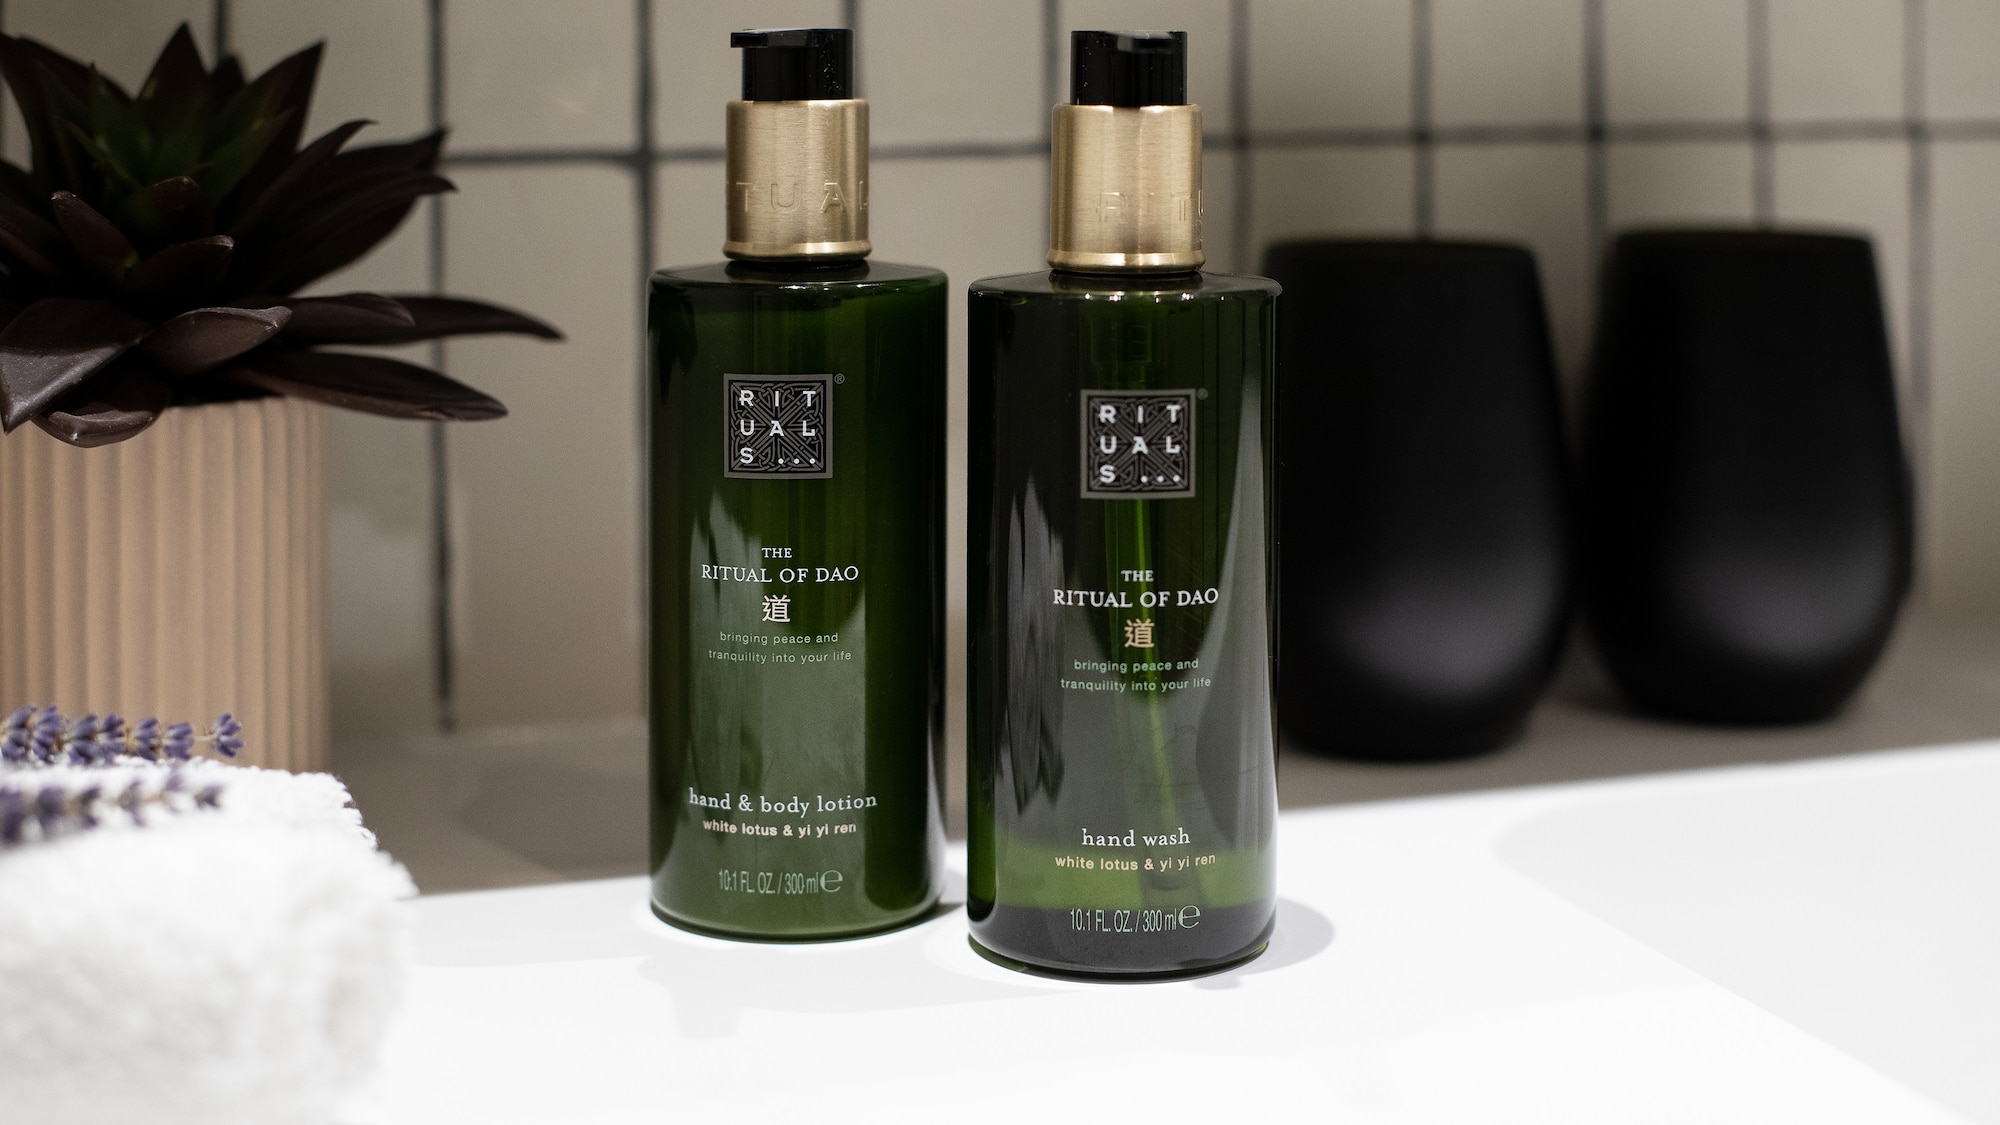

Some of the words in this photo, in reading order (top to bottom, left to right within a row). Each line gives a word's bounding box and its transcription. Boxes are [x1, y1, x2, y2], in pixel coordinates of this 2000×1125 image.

[762, 547, 792, 558] THE
[701, 563, 772, 583] RITUAL
[779, 568, 809, 583] OF
[815, 565, 859, 582] DAO
[1121, 569, 1154, 582] THE
[1053, 588, 1133, 608] RITUAL
[1140, 591, 1170, 608] OF
[1176, 587, 1218, 607] DAO
[762, 594, 791, 623] 道
[720, 631, 768, 645] bringing
[773, 634, 811, 645] peace
[816, 632, 838, 643] and
[1124, 618, 1155, 648] 道
[709, 649, 767, 664] tranquility
[772, 652, 796, 663] into
[801, 654, 828, 664] your
[833, 650, 852, 661] life
[1074, 659, 1127, 673] bringing
[1133, 661, 1172, 672] peace
[1177, 658, 1199, 670] and
[1061, 678, 1126, 693] tranquility
[1131, 680, 1156, 691] into
[1161, 681, 1188, 692] your
[1193, 677, 1211, 687] life
[689, 787, 732, 810] hand
[738, 794, 753, 812] &
[760, 795, 810, 818] body
[817, 794, 878, 812] lotion
[703, 819, 737, 834] white
[742, 823, 778, 836] lotus
[783, 824, 793, 836] &
[798, 824, 811, 838] yi
[816, 824, 828, 838] yi
[834, 824, 857, 834] ren
[1082, 828, 1135, 847] hand
[1142, 827, 1191, 846] wash
[1055, 855, 1095, 869] white
[1101, 858, 1138, 871] lotus
[1144, 858, 1154, 870] &
[1160, 857, 1172, 872] yi
[1178, 856, 1190, 871] yi
[1195, 853, 1216, 866] ren
[718, 869, 737, 891] 10.1
[1070, 908, 1091, 931] 10.1
[1096, 910, 1111, 932] FL.
[1114, 909, 1132, 933] OZ.
